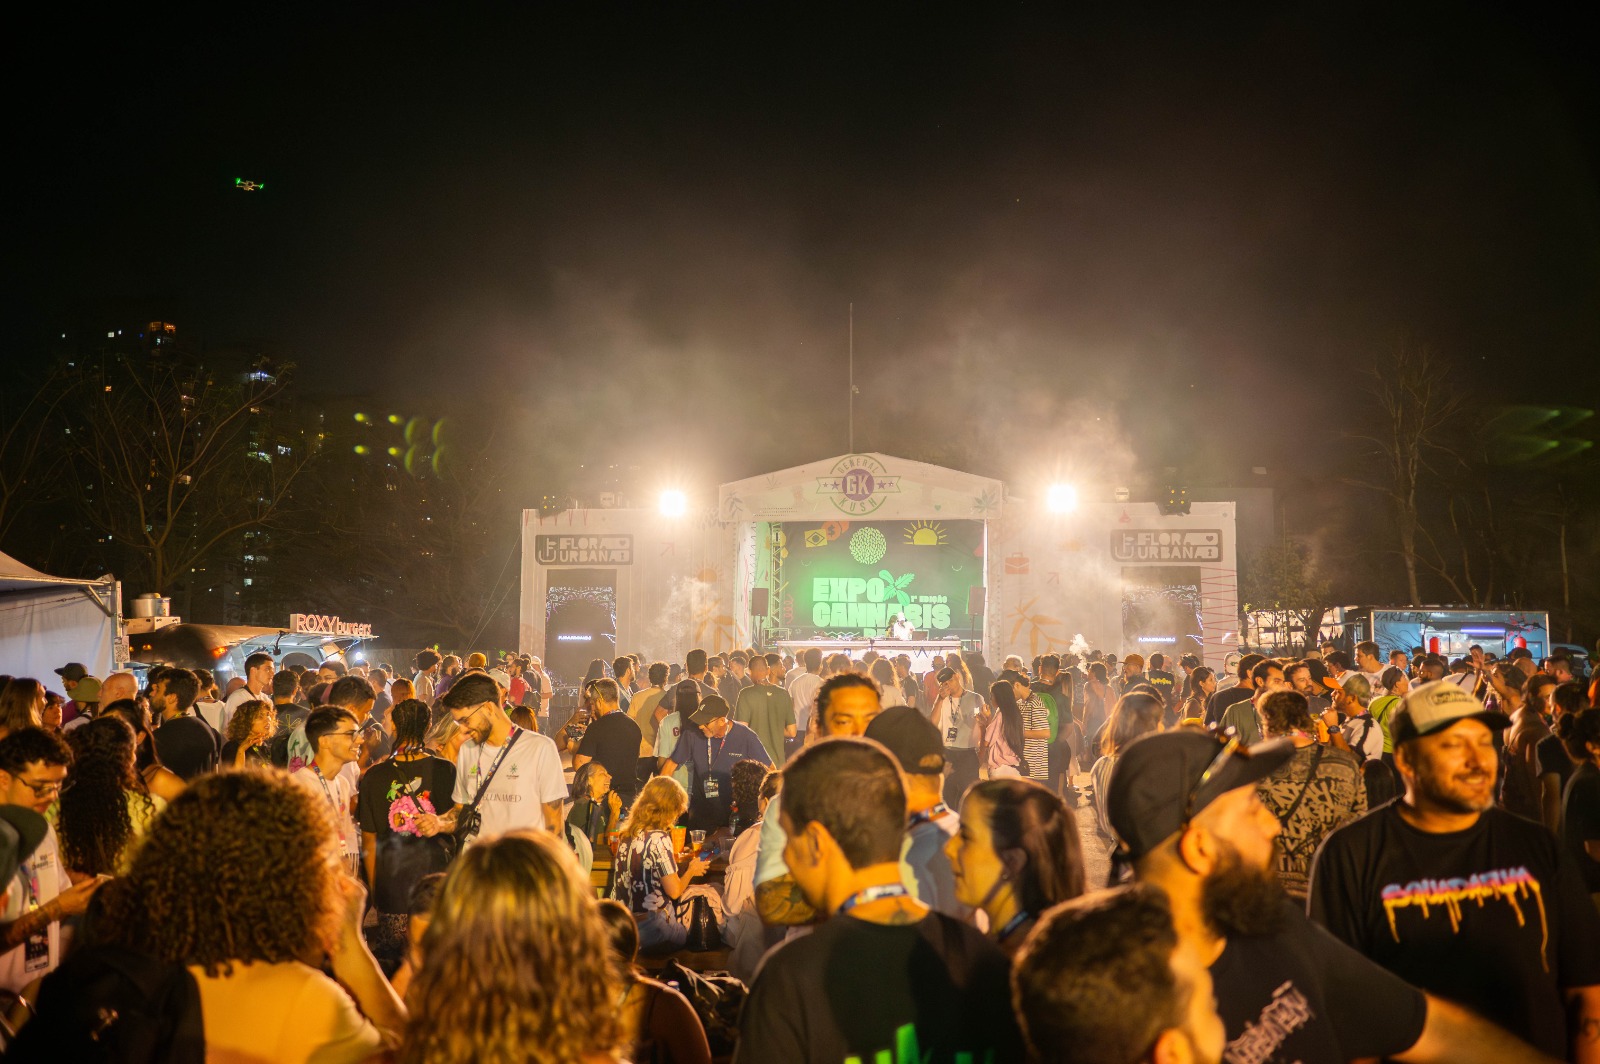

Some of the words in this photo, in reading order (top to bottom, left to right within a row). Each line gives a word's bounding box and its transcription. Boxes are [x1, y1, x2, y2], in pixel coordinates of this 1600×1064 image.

[837, 458, 879, 474] GENERAL
[846, 475, 870, 495] GK
[839, 497, 877, 512] KUSH
[560, 537, 612, 549] FLORA
[1137, 532, 1196, 546] FLORA
[559, 550, 618, 562] URBANA
[1137, 546, 1205, 559] URBANA
[813, 577, 885, 602] EXPO
[812, 602, 951, 629] CANNABIS
[1374, 612, 1403, 622] YAKI
[1408, 611, 1432, 622] FRY
[296, 613, 337, 634] ROXY
[337, 616, 372, 636] burgers
